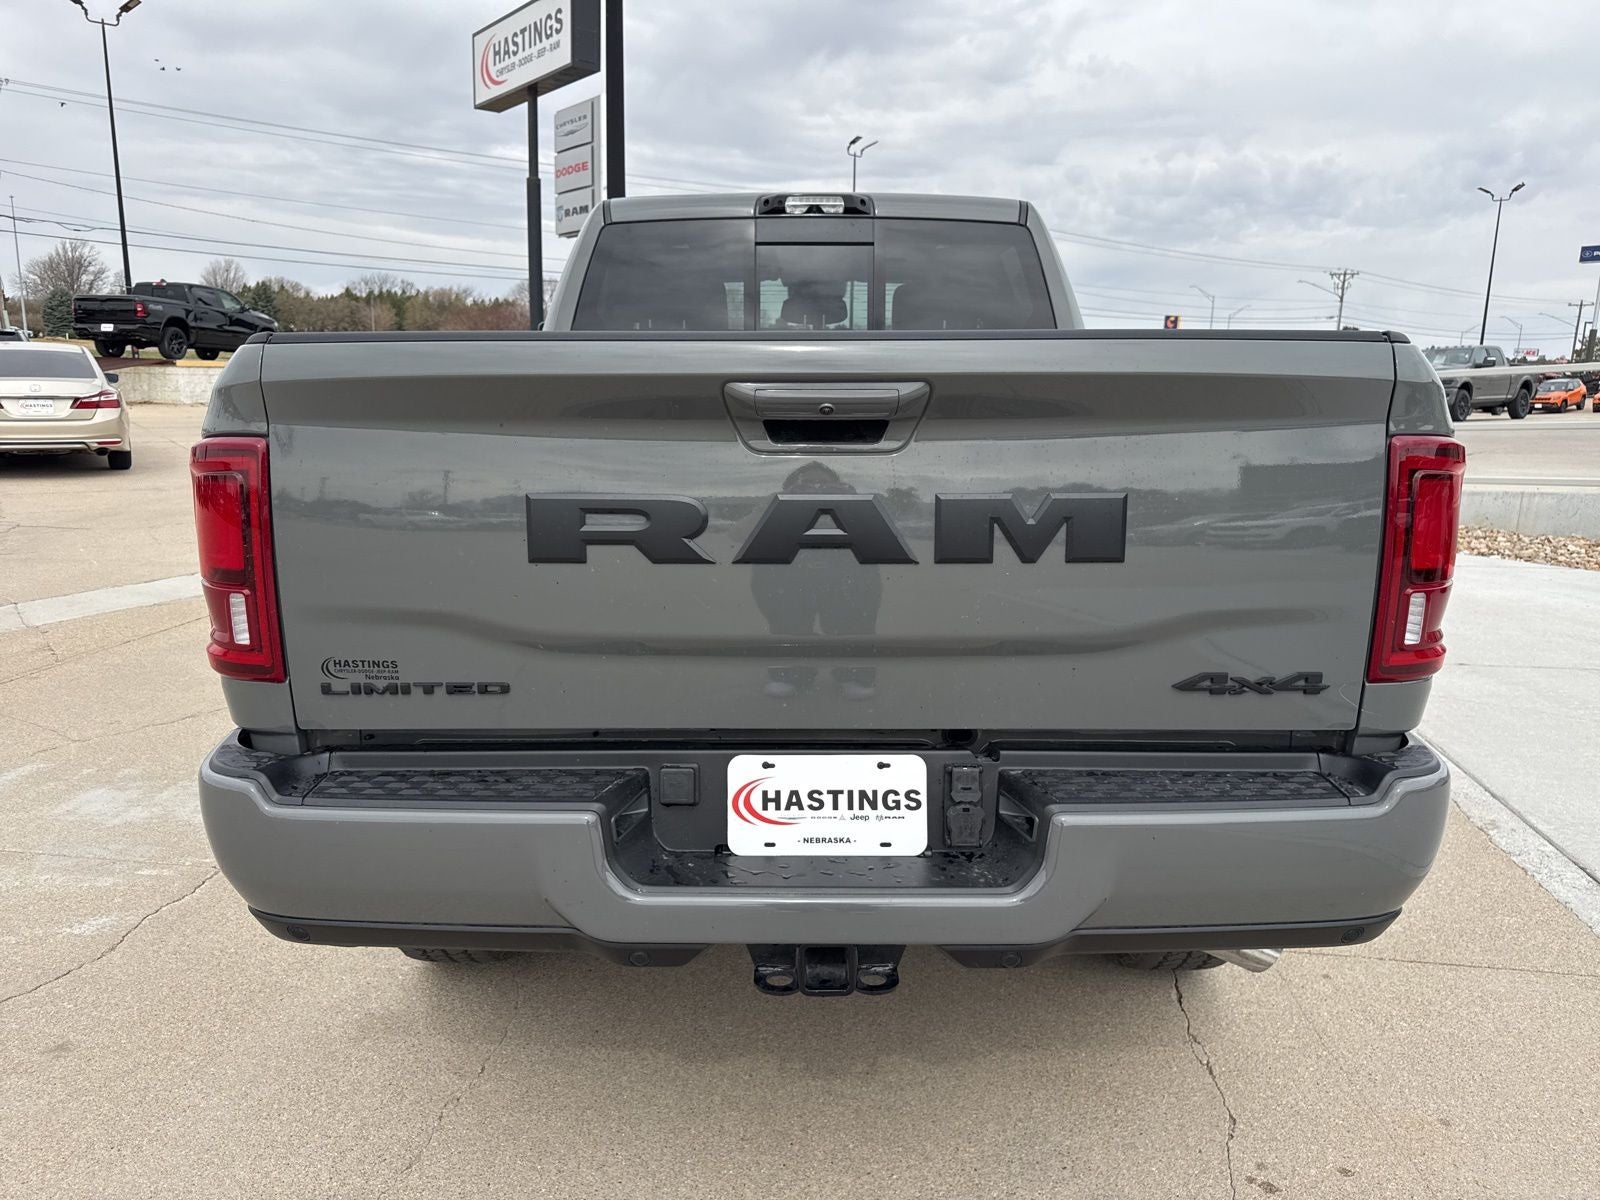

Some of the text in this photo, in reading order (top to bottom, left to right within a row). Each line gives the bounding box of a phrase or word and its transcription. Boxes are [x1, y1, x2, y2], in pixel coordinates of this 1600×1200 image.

[492, 7, 563, 67] HASTINGS
[556, 114, 588, 130] CHRYSLER
[556, 161, 589, 179] DODGE
[564, 205, 589, 218] RAM
[525, 492, 1128, 565] RAM
[333, 659, 398, 669] HASTINGS
[320, 682, 511, 696] LIMITED
[761, 789, 922, 811] HASTINGS
[850, 813, 870, 822] Jeep
[802, 836, 852, 845] NEBRASKA
